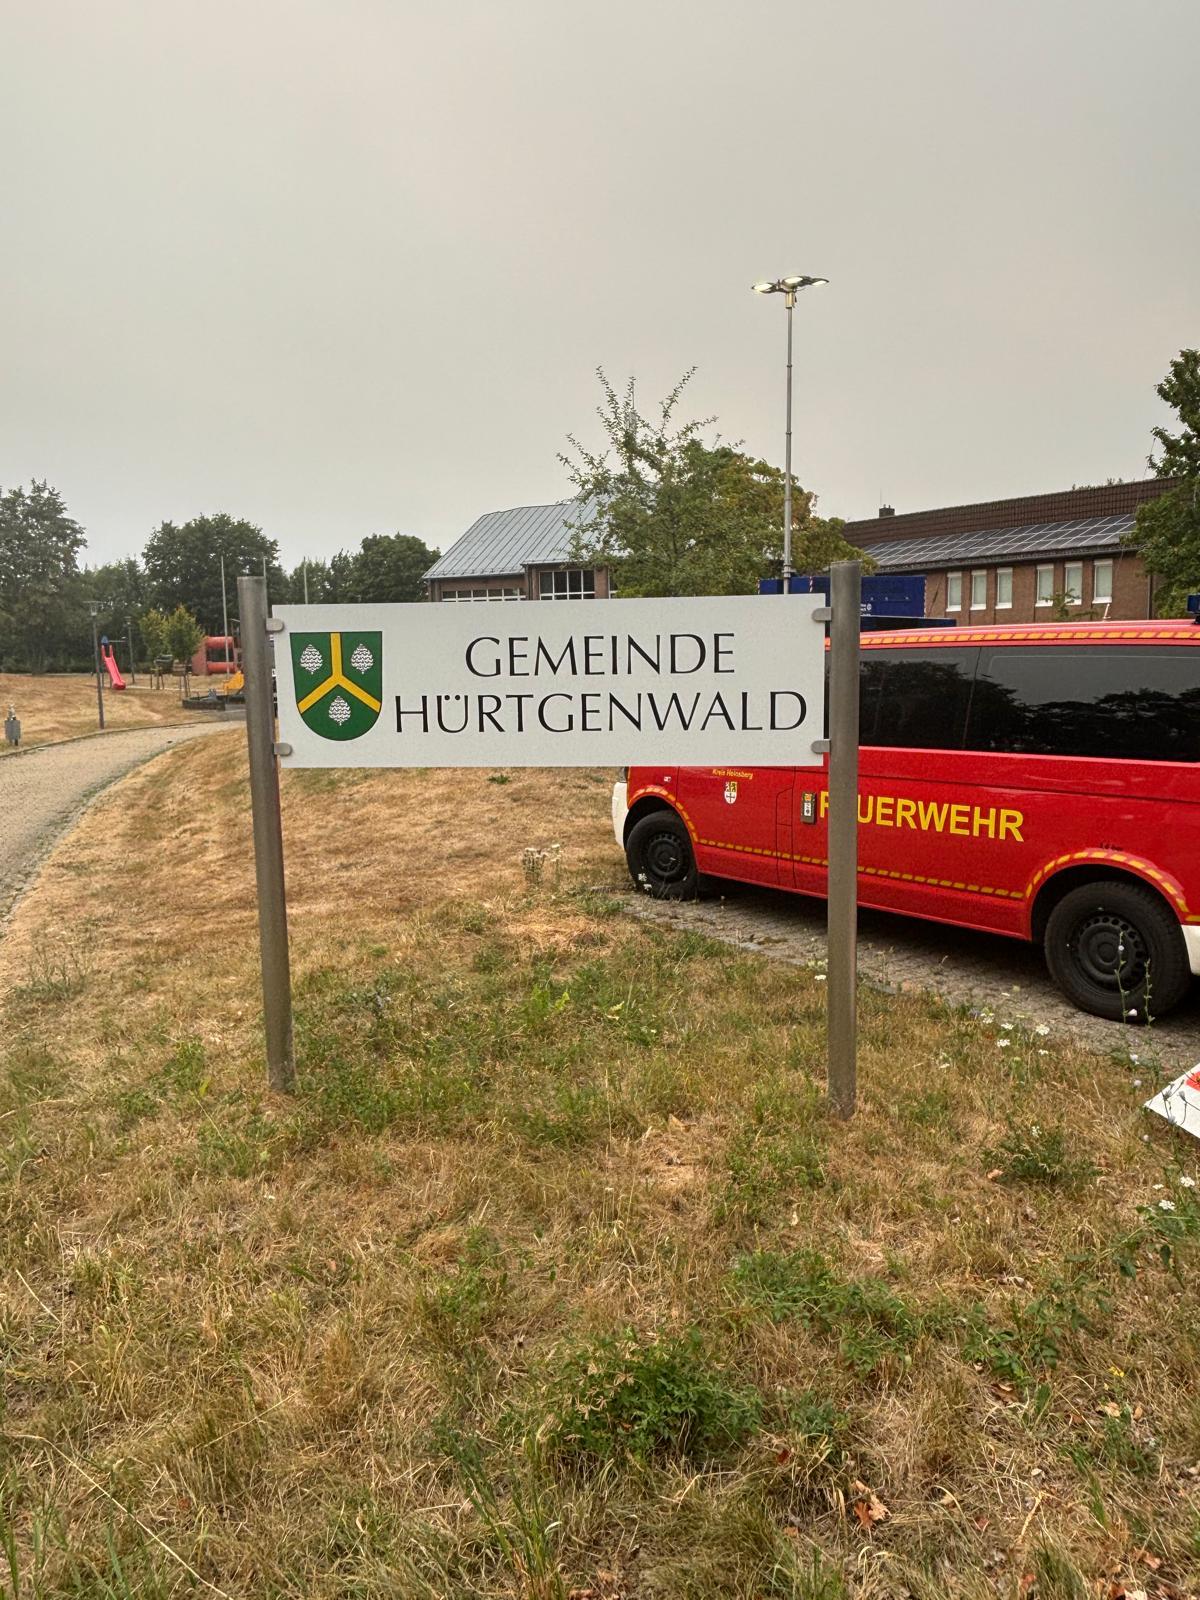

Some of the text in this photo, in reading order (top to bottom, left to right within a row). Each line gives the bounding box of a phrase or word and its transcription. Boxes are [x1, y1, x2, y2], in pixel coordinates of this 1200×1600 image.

[465, 632, 735, 678] GEMEINDE
[395, 690, 807, 734] HÜRTGENWALD
[820, 790, 1024, 842] FUERWEHR
